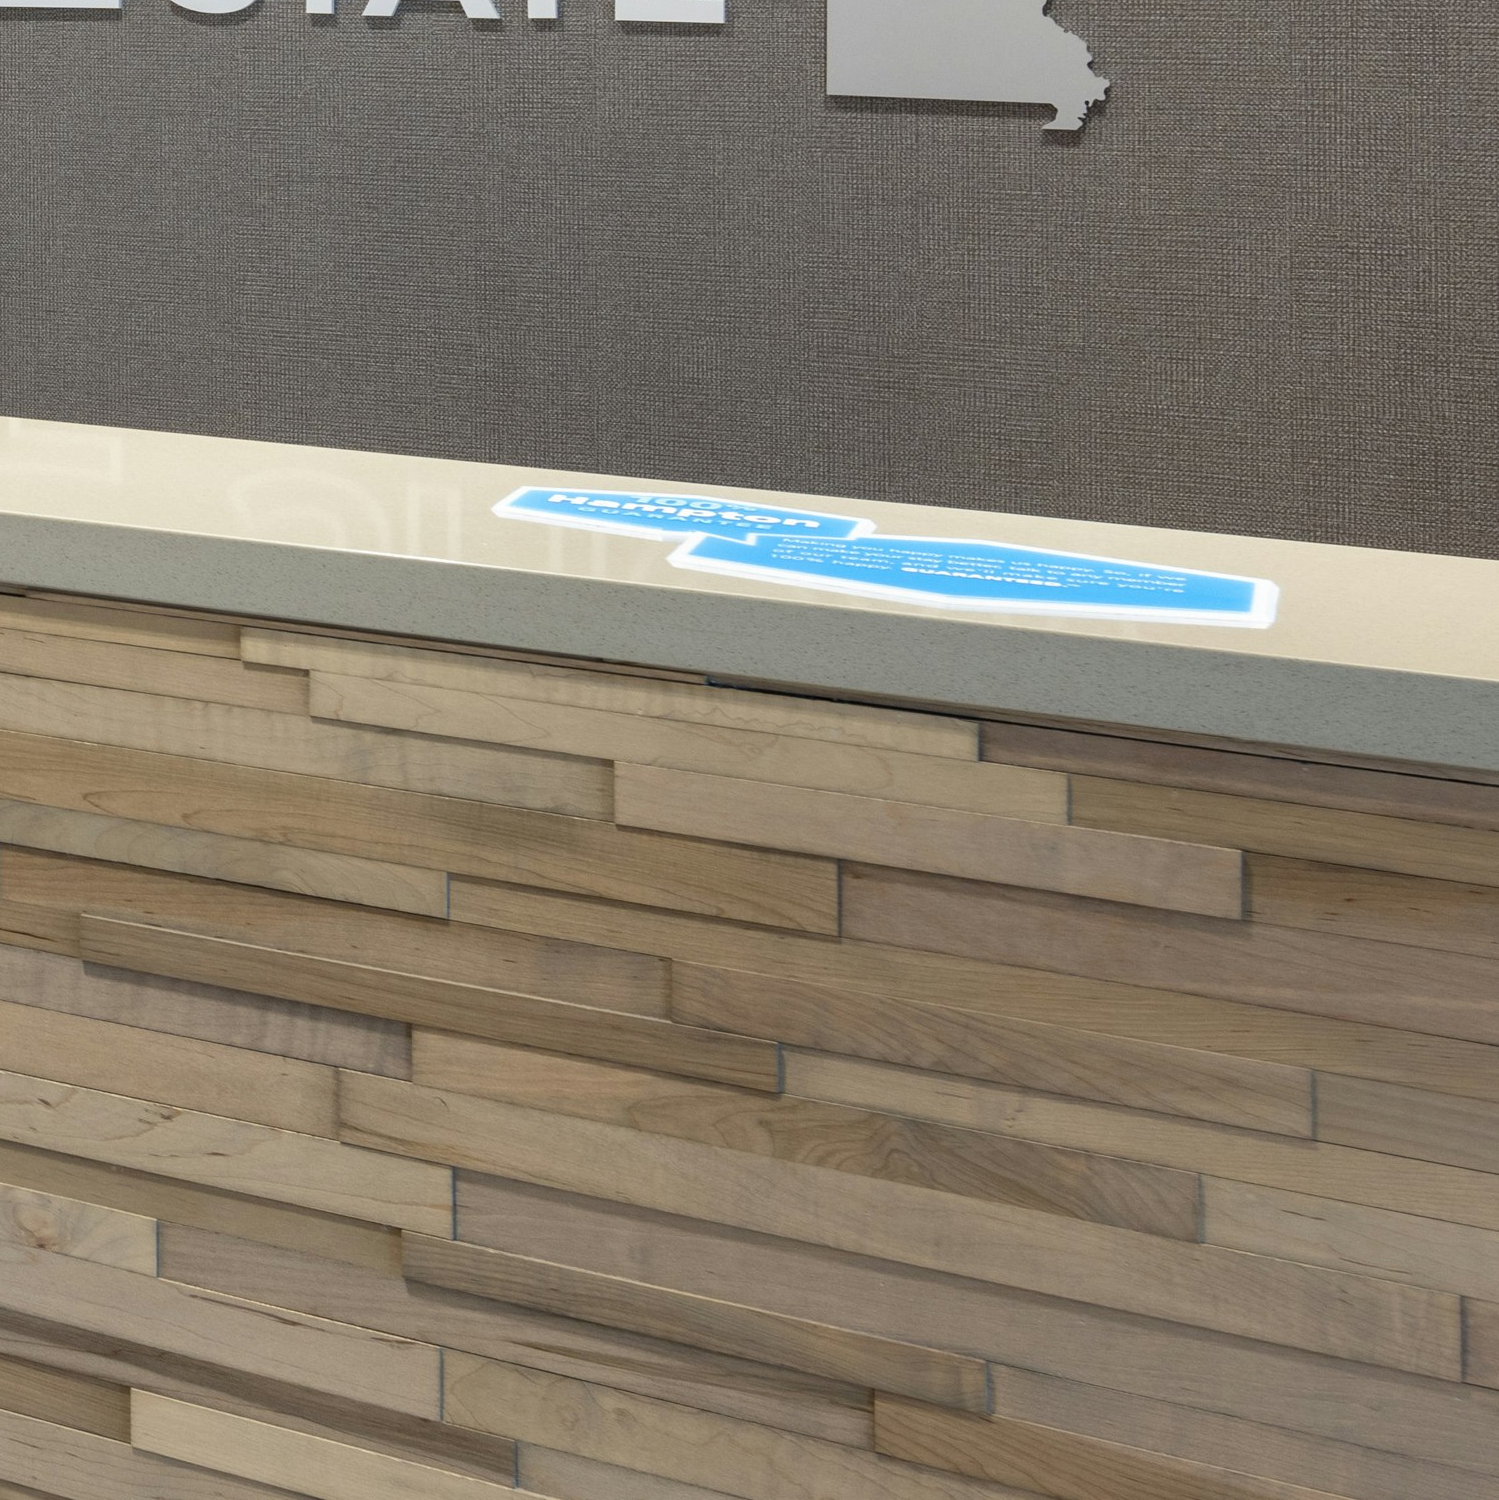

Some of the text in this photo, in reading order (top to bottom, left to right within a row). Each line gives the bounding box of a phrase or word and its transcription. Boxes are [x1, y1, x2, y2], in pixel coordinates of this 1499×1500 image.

[547, 493, 821, 529] Hampton
[578, 506, 772, 530] GUARANTEE
[812, 547, 860, 555] make
[1107, 576, 1185, 587] member
[889, 548, 943, 558] happy
